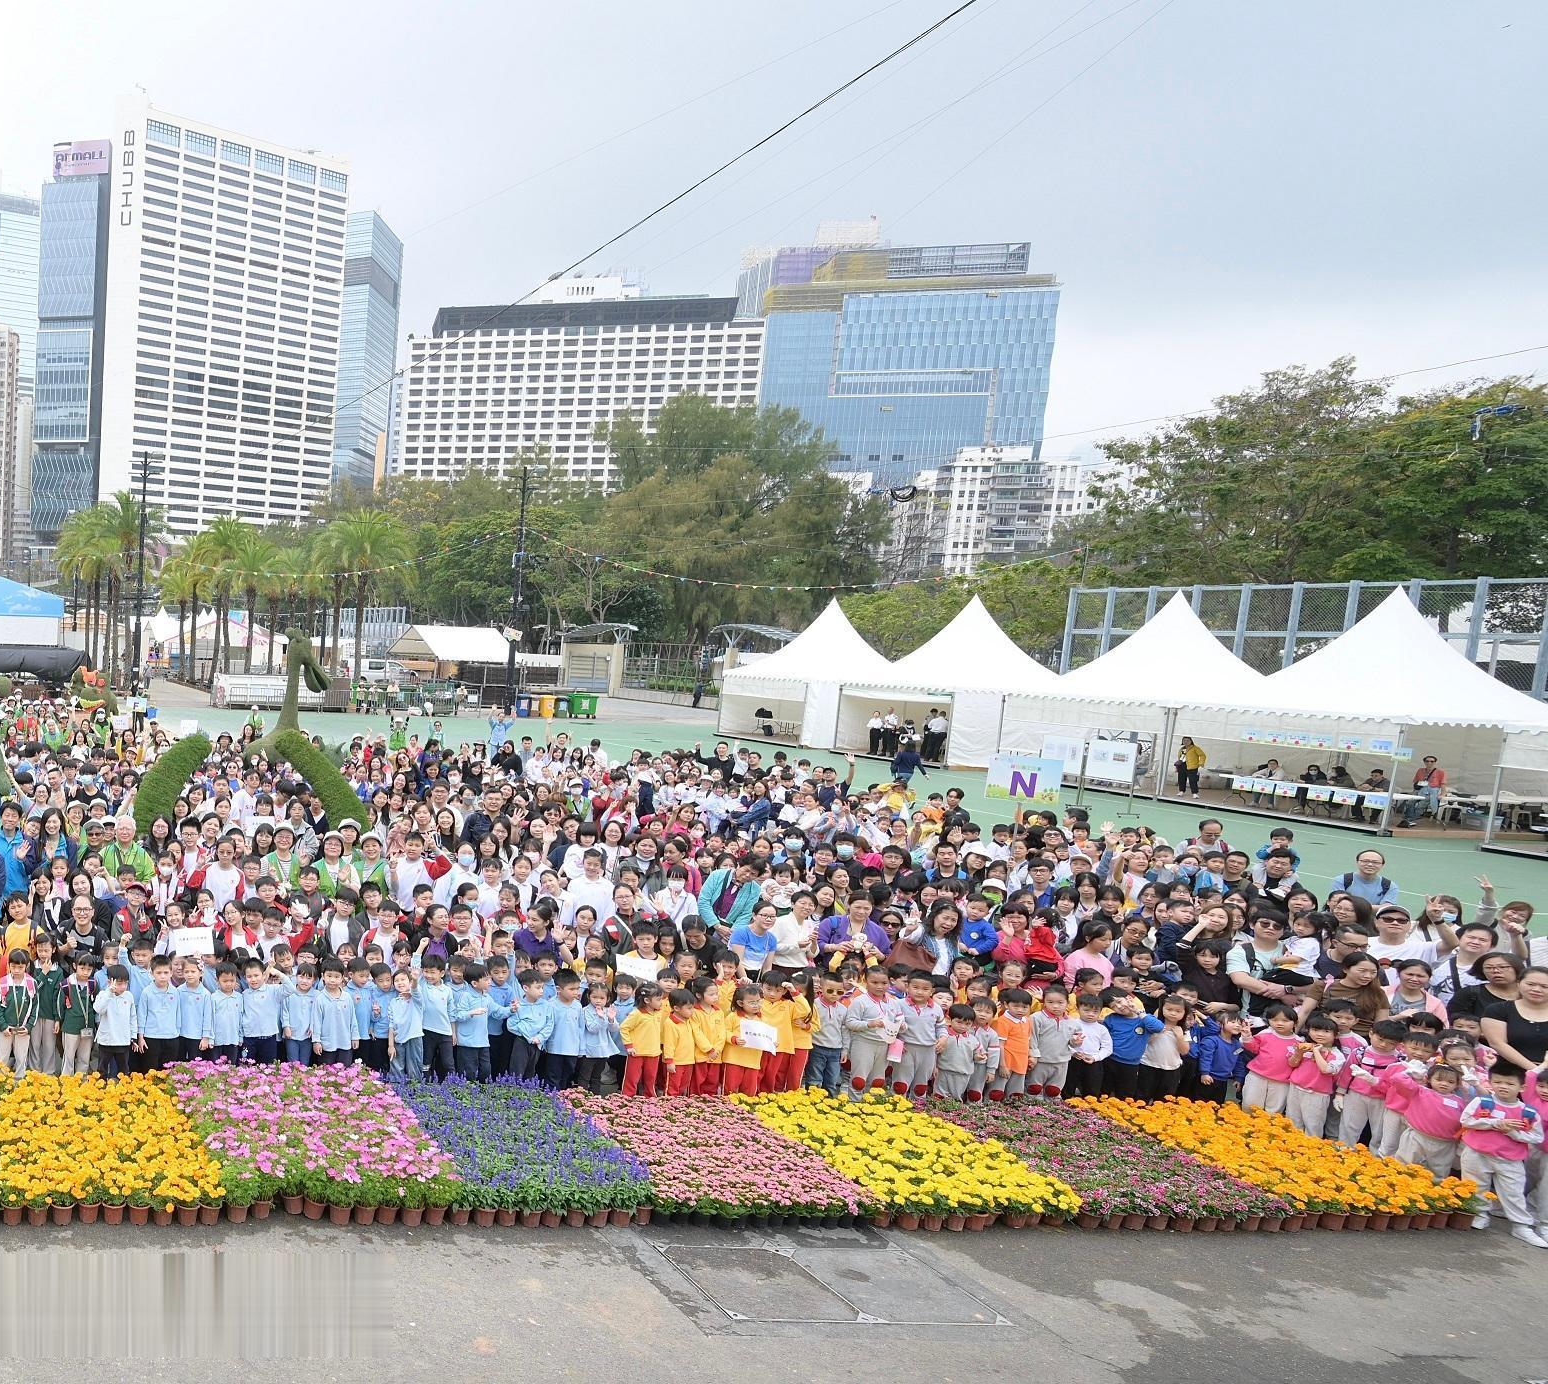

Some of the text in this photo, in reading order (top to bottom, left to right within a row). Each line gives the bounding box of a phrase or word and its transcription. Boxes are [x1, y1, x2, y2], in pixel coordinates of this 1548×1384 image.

[120, 130, 134, 226] CHUBB
[133, 701, 140, 710] F
[1009, 770, 1038, 798] N
